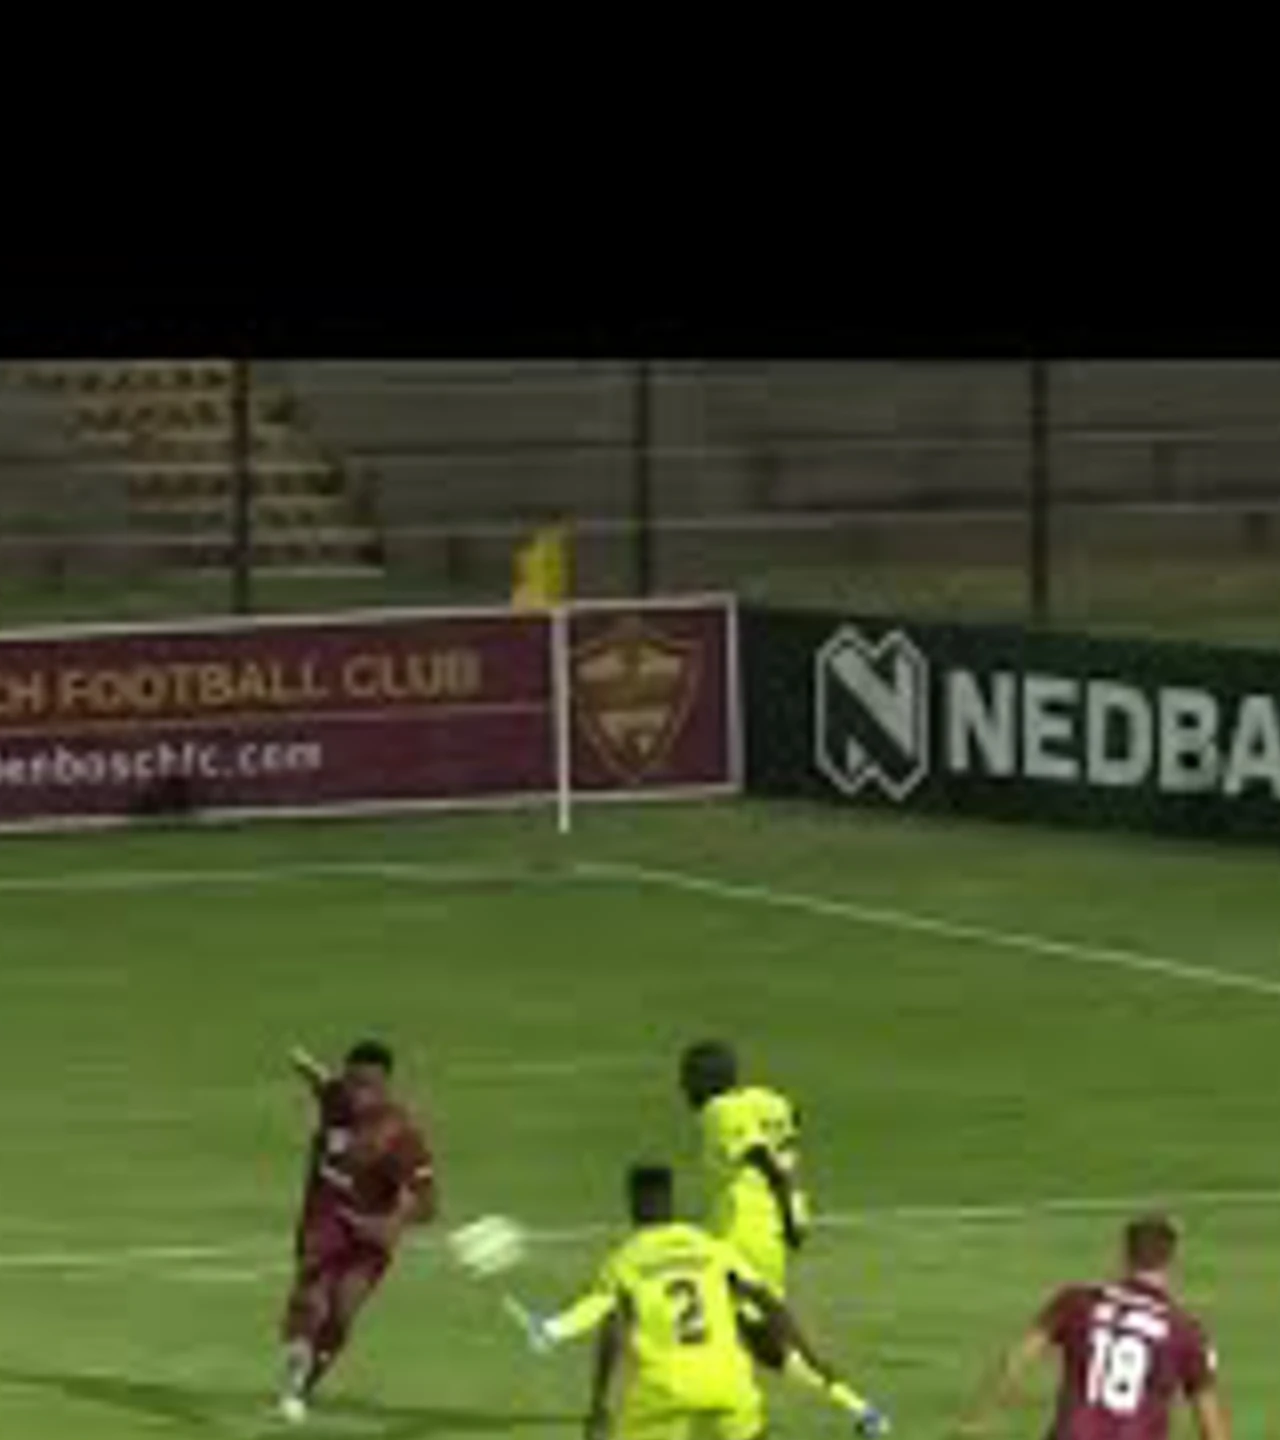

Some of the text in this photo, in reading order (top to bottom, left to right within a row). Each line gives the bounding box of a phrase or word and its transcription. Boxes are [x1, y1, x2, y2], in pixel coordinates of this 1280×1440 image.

[58, 659, 324, 711] FOOTBALL
[340, 649, 484, 698] CLUB
[666, 1278, 708, 1346] 2
[1086, 1326, 1150, 1415] 18
